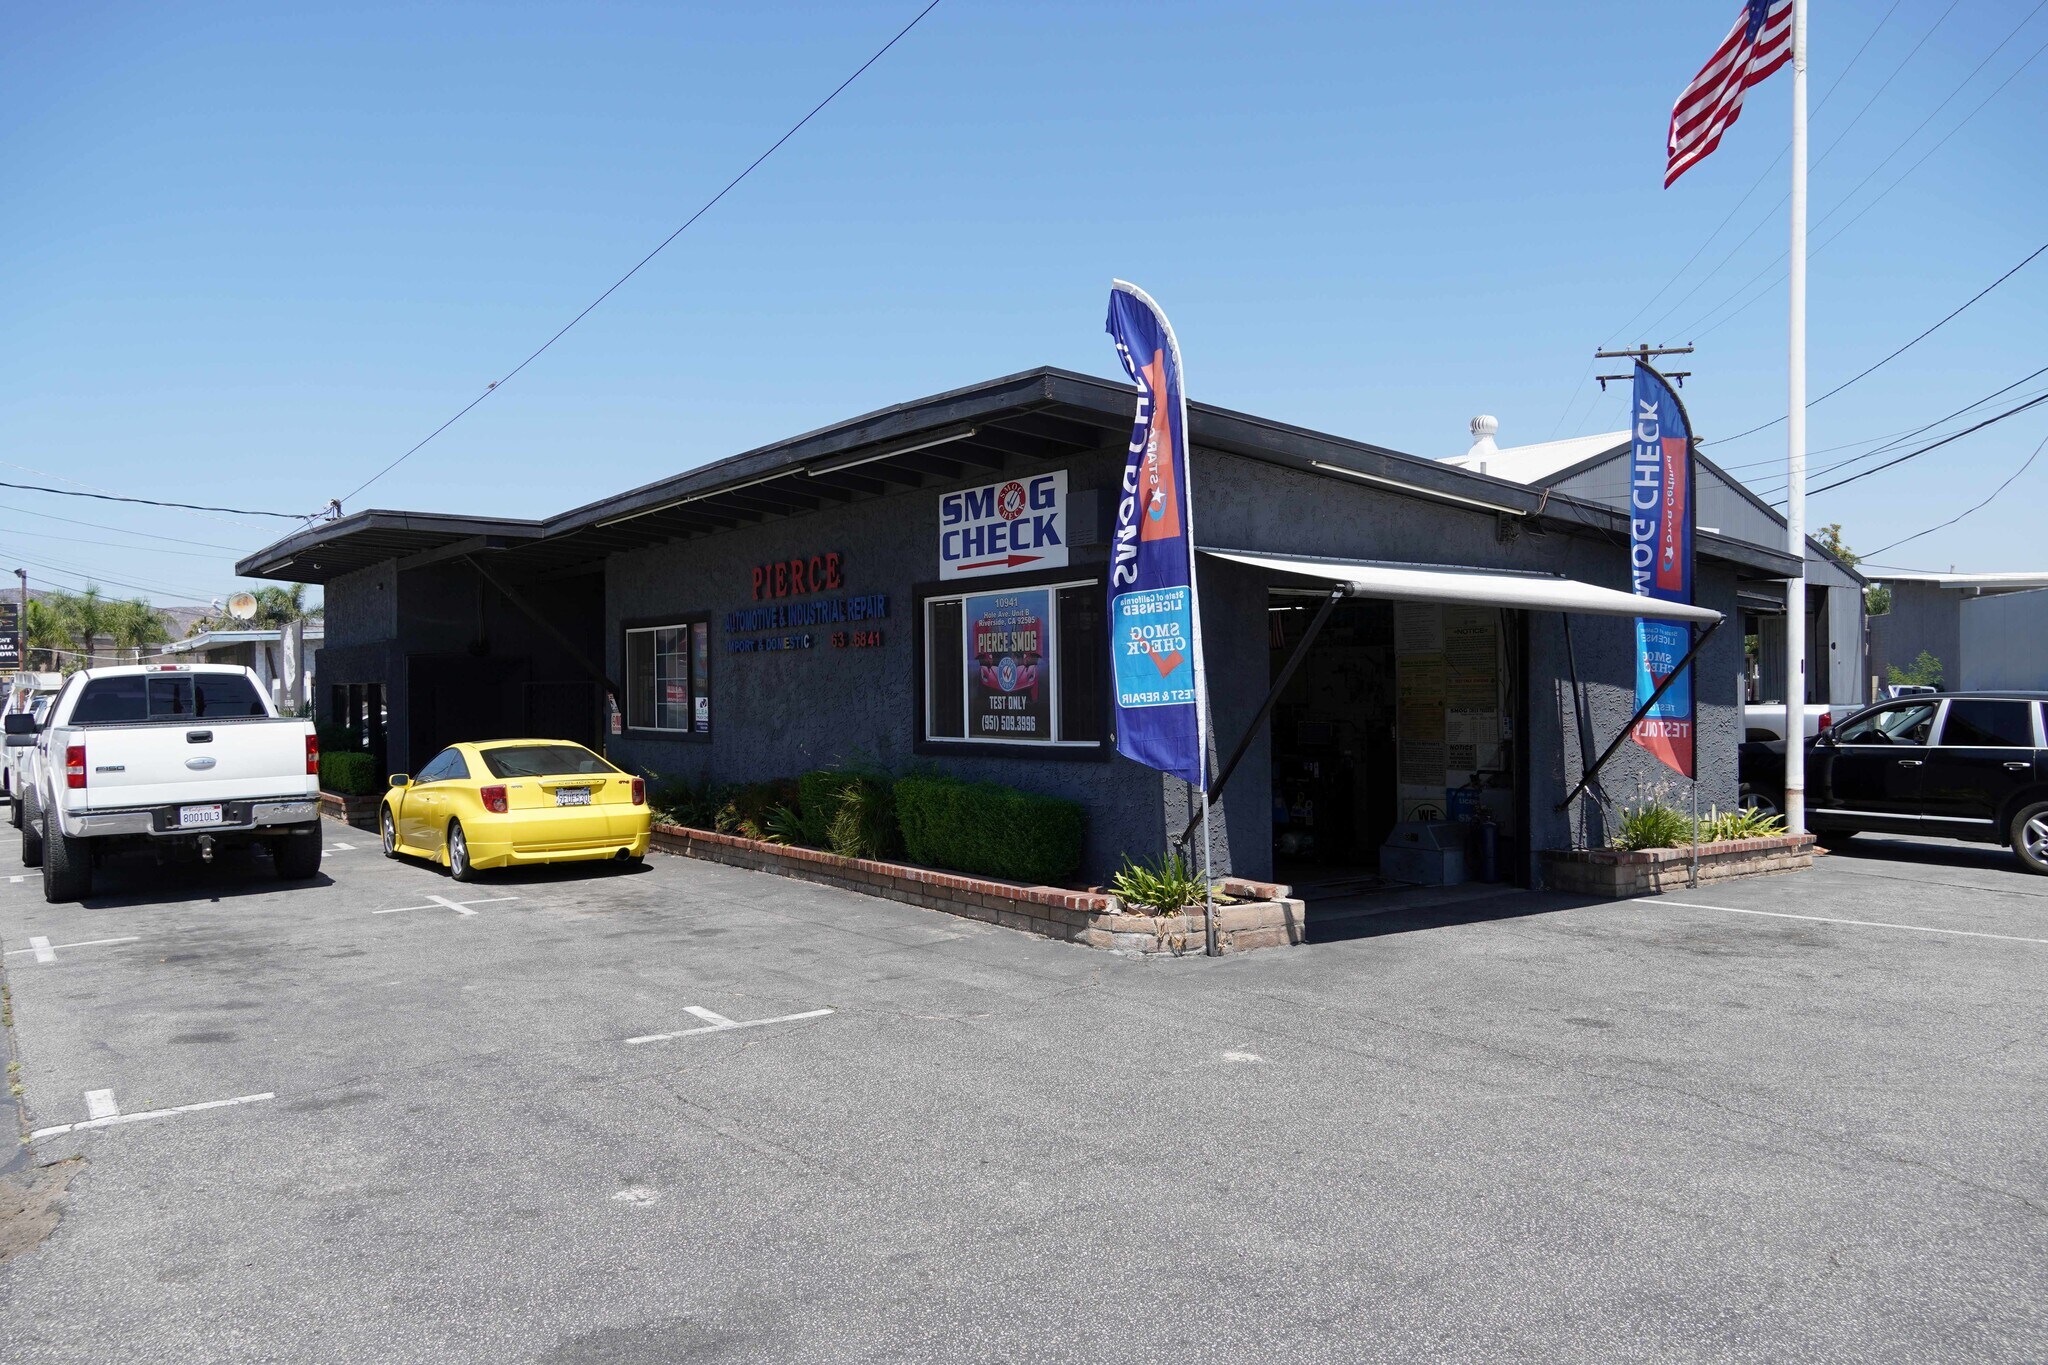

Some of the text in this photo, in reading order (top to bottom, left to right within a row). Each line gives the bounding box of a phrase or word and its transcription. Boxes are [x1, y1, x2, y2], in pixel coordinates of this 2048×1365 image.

[1000, 483, 1024, 498] SMOG
[998, 503, 1025, 519] CHECK
[942, 512, 1062, 561] CHECK
[752, 552, 840, 600] PIERCE
[995, 597, 1018, 608] 10941
[725, 592, 886, 633] AUTOMOTIVE & INDUSTRIAL REPAIR
[1011, 609, 1024, 617] Unit
[1008, 617, 1016, 625] CA
[757, 639, 764, 651] &
[765, 634, 810, 650] DOMESTIC
[978, 630, 1037, 653] PIERCE SMOG
[989, 695, 1027, 710] TEST ONLY
[981, 714, 1036, 732] (951) 509.3996
[183, 811, 220, 823] 80010L3
[1418, 809, 1437, 820] WE
